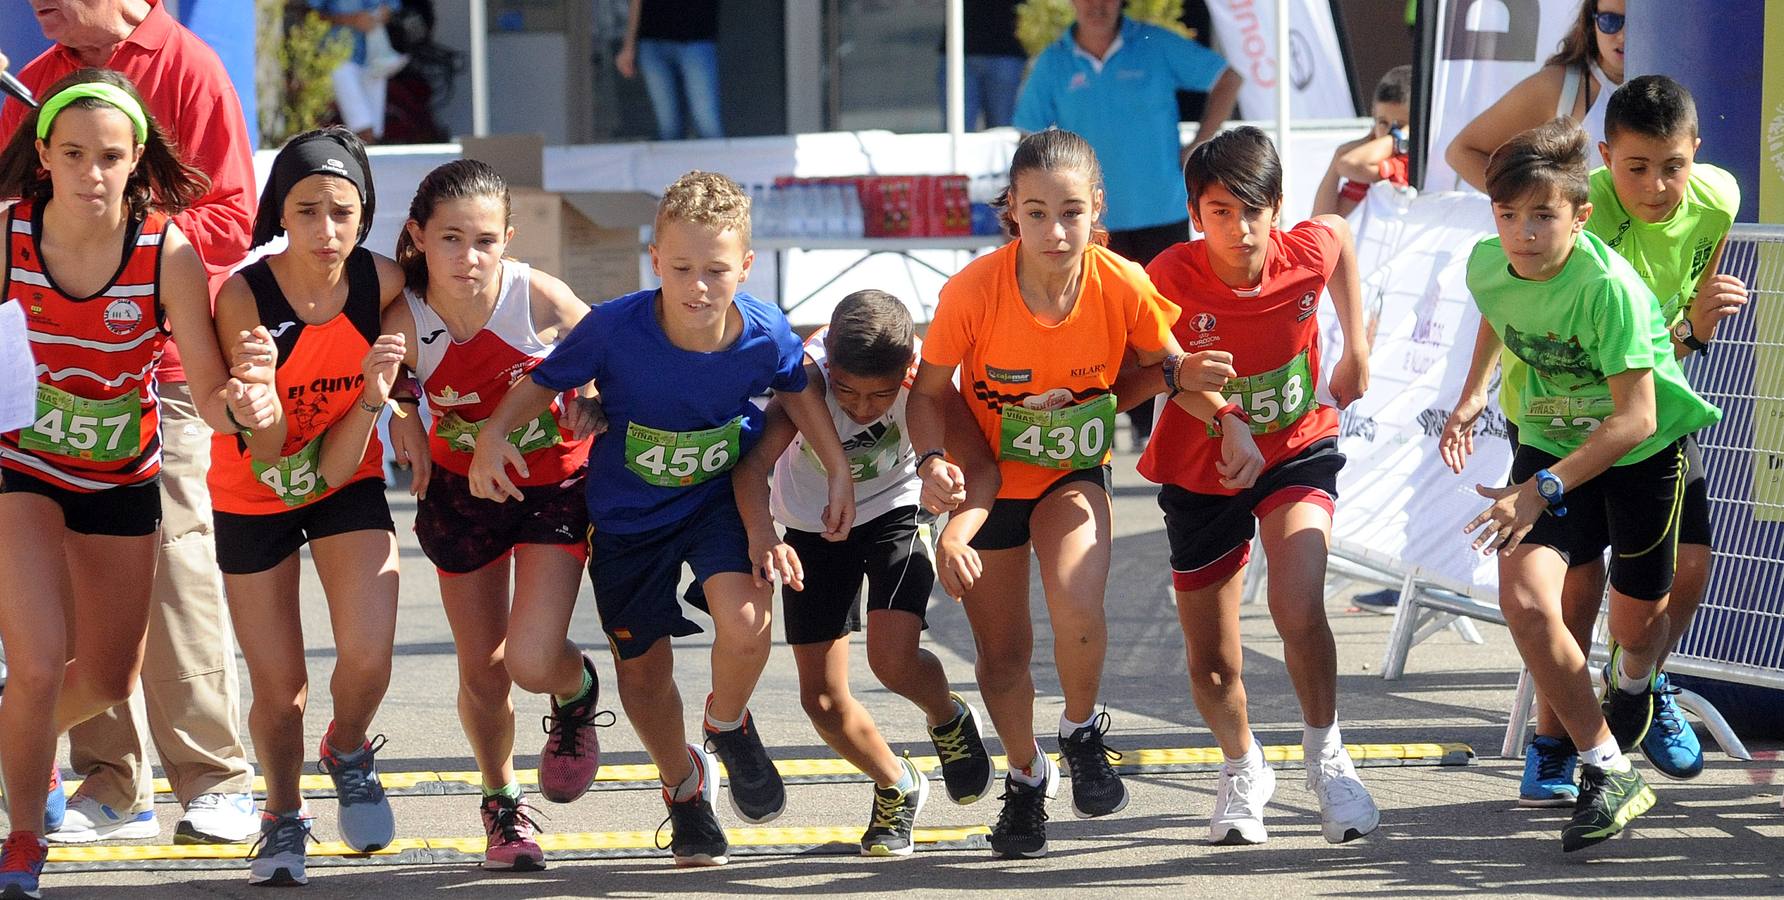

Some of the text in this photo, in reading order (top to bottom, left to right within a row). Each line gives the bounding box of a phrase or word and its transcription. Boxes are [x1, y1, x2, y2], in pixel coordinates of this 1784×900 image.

[310, 373, 365, 393] CHIVO
[34, 408, 131, 451] 457
[1012, 417, 1105, 460] 430
[635, 439, 729, 477] 456
[260, 460, 323, 497] 45
